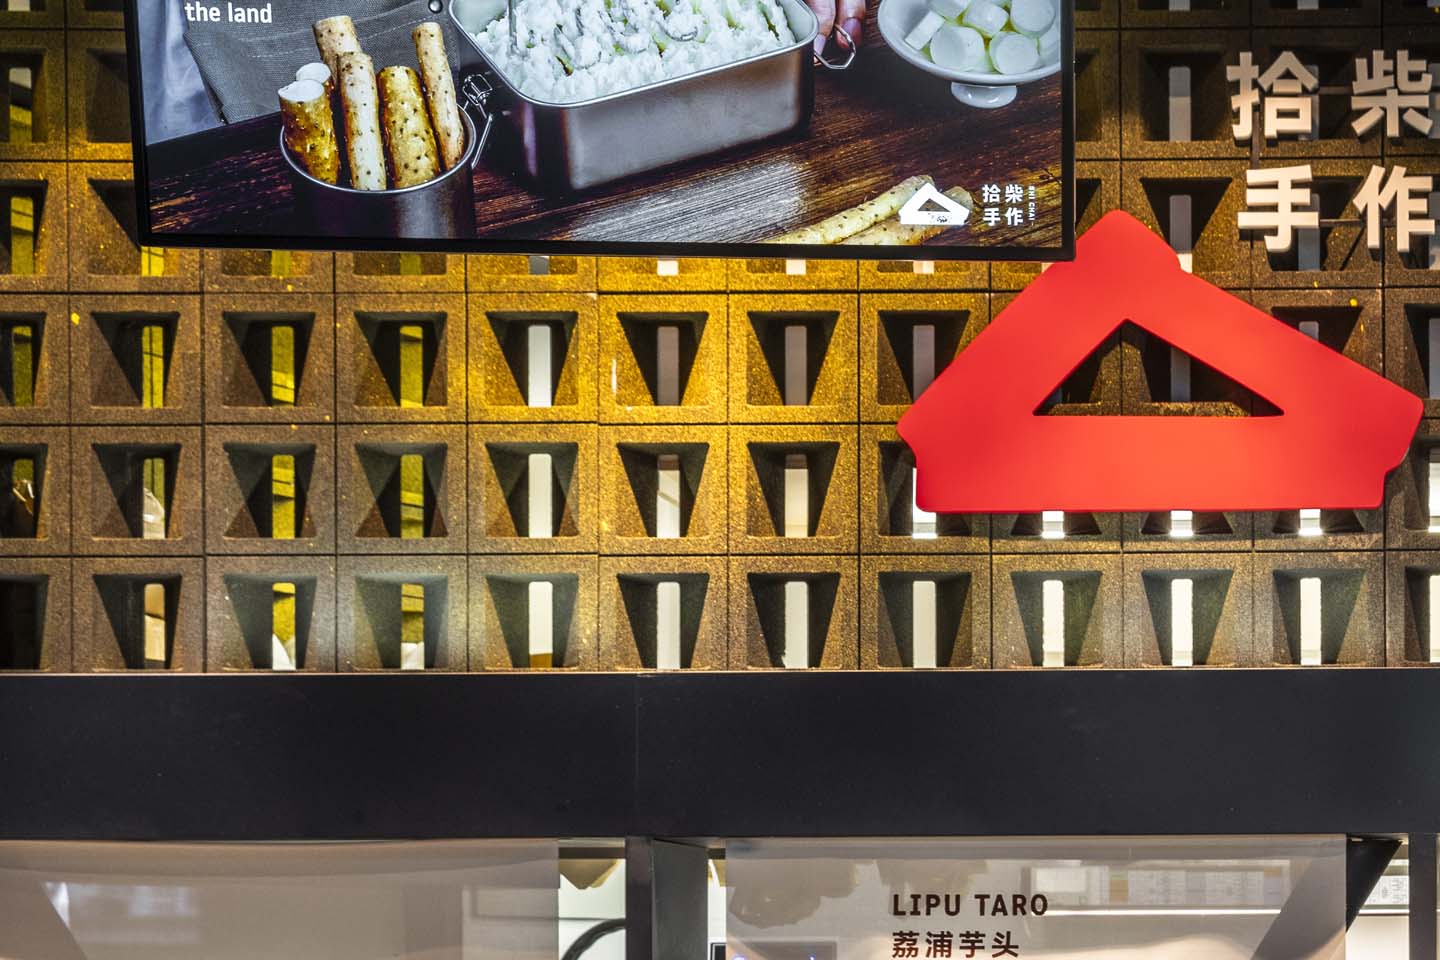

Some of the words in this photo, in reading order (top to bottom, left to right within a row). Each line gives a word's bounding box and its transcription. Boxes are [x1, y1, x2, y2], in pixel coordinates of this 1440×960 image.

[184, 1, 221, 22] the
[227, 2, 273, 23] land
[1226, 50, 1434, 140] 拾柴
[981, 184, 1024, 203] 拾柴
[982, 207, 1024, 226] 手作
[1237, 164, 1436, 252] 手作
[892, 893, 961, 917] LIPU
[974, 893, 1049, 917] TARO
[892, 930, 1020, 959] 荔浦芋头
